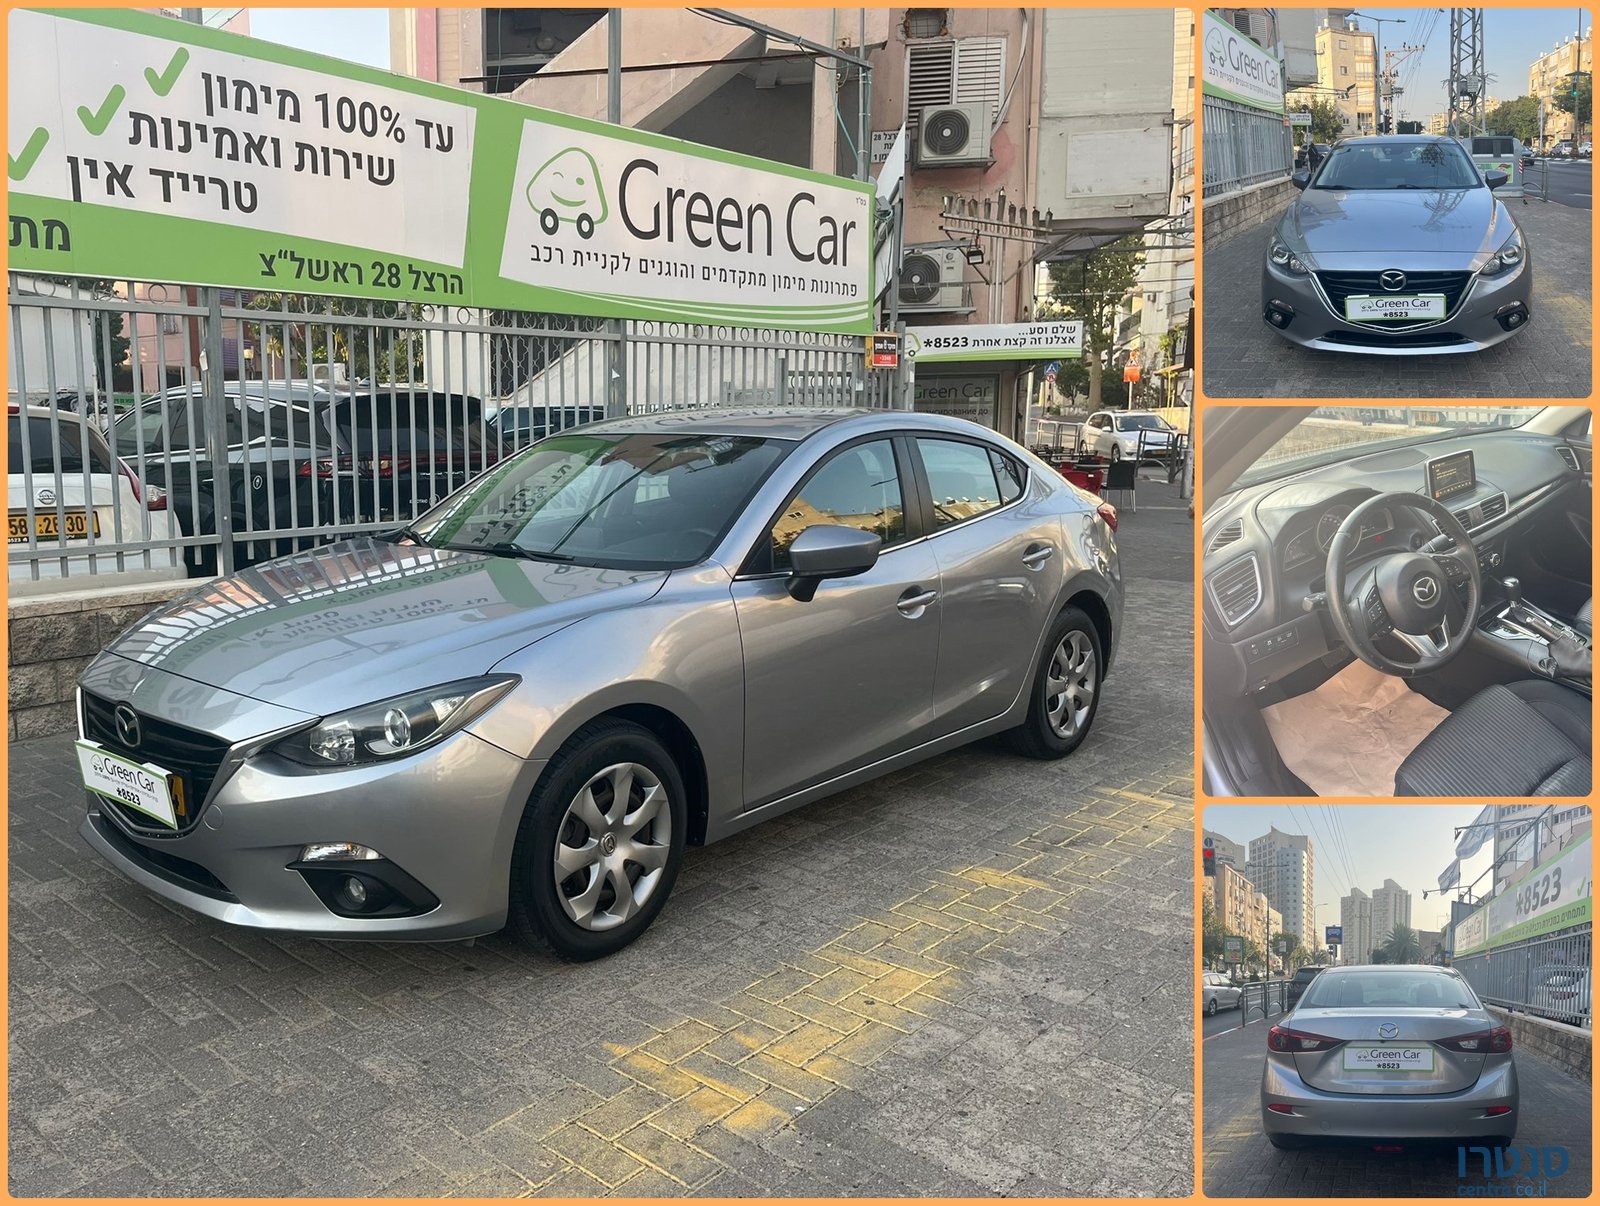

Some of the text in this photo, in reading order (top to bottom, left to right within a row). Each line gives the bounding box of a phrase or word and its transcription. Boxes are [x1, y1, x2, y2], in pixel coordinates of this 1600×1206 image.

[1228, 36, 1264, 84] Green
[1264, 59, 1278, 90] Car
[201, 72, 455, 153] עד 100% מימון
[128, 110, 396, 187] שירות ואמינות
[67, 155, 259, 215] טרייד אין
[618, 158, 856, 268] Green Car
[371, 260, 402, 290] 28
[407, 263, 464, 296] הרצל
[530, 244, 858, 297] פתרונות מימון מתקדמים והוגנים לקניית רכב
[1375, 298, 1432, 308] Green Car
[971, 338, 1000, 347] אחרת
[1003, 338, 1027, 348] קצת
[1030, 336, 1042, 345] זה
[1045, 335, 1076, 345] אצלנו
[1051, 324, 1076, 334] שלם
[962, 383, 990, 398] Car
[103, 757, 137, 785] Green
[136, 770, 155, 793] Car
[1370, 1049, 1421, 1059] Green Car
